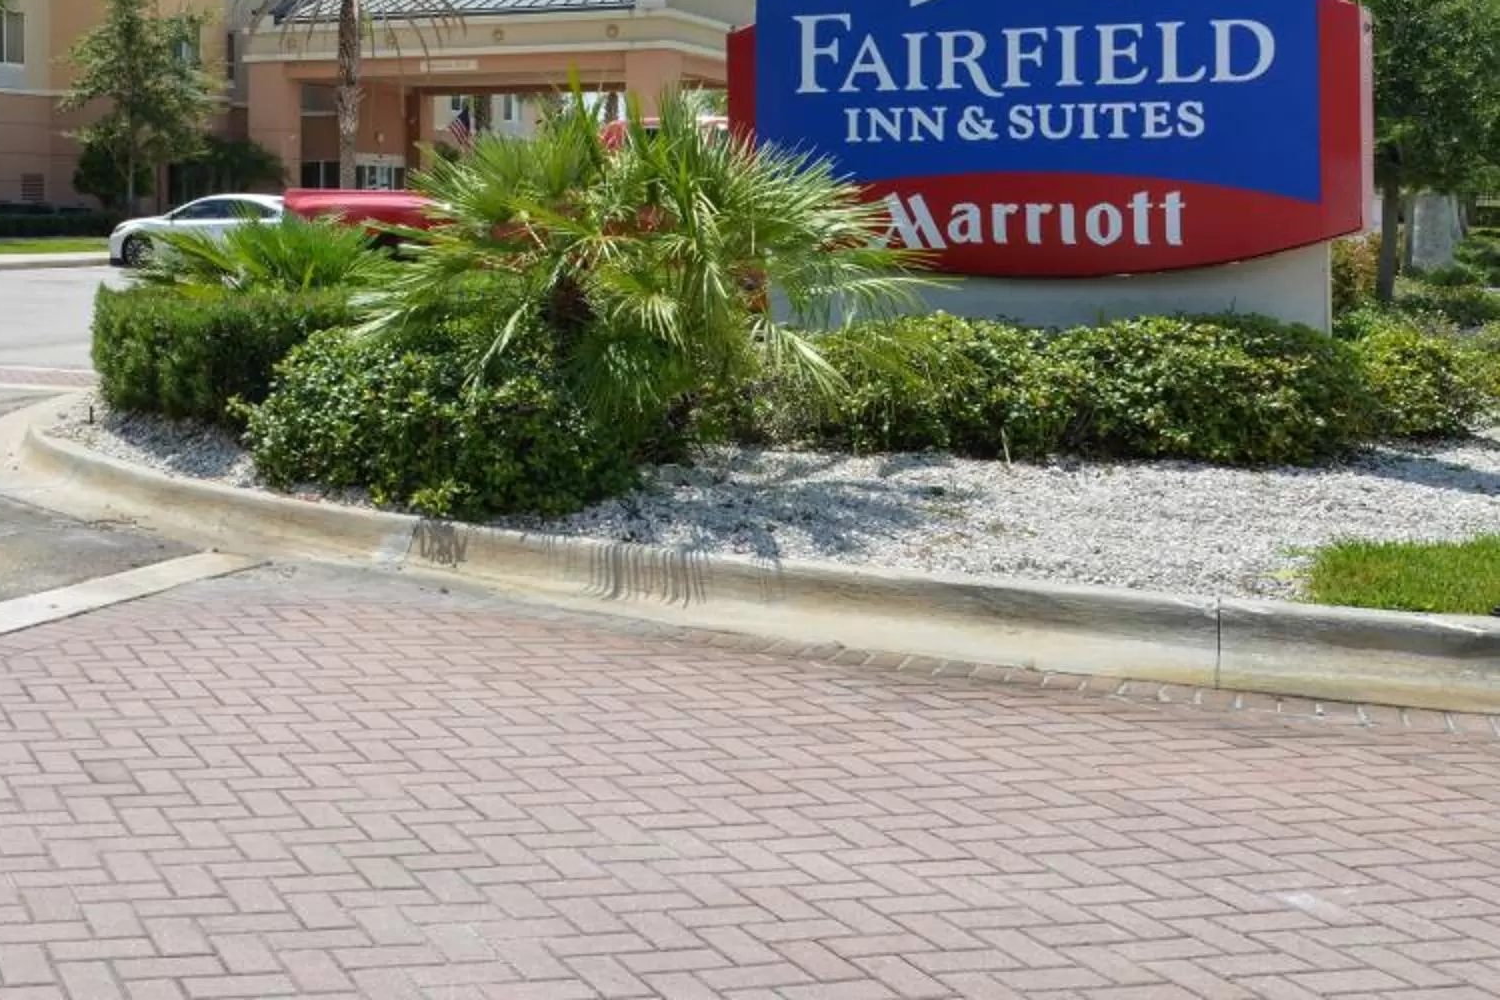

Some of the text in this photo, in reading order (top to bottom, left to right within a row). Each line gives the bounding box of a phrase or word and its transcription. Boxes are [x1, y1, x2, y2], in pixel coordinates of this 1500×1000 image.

[791, 13, 1276, 98] FAIRFIELD
[843, 100, 1206, 143] INN & SUITES
[868, 190, 1187, 249] Marriott
